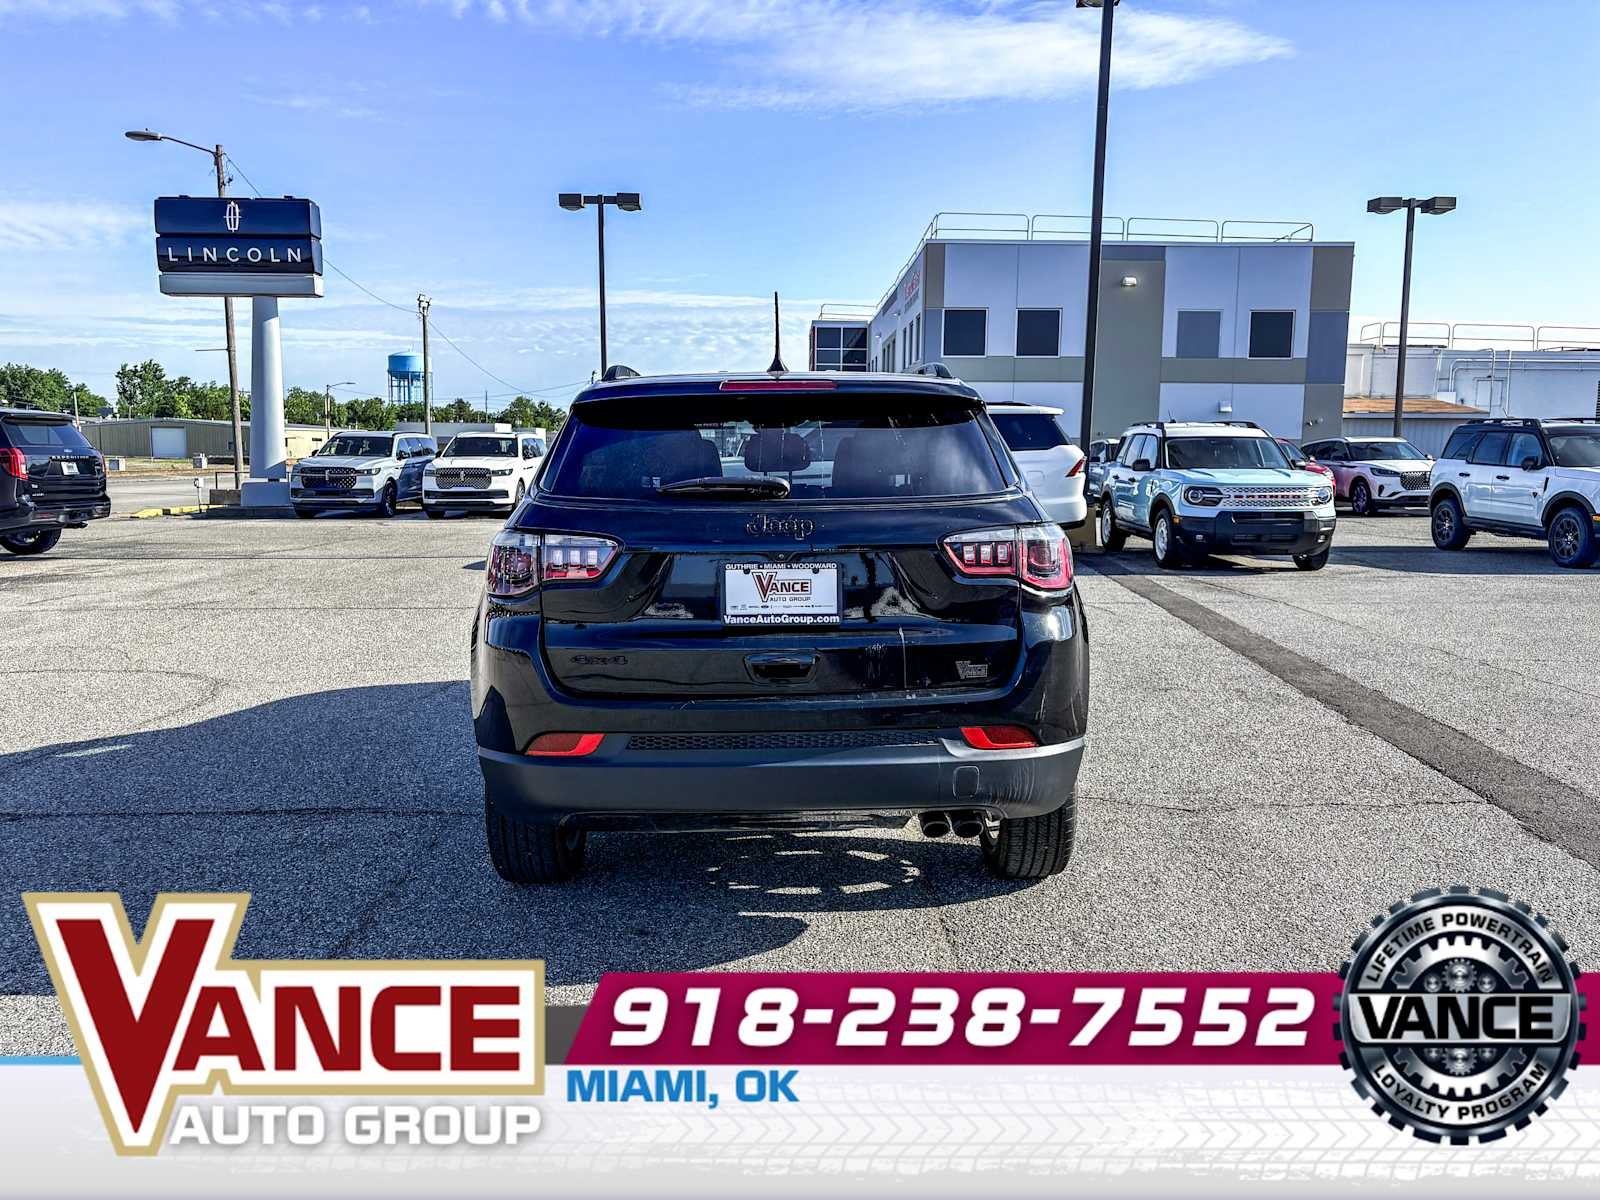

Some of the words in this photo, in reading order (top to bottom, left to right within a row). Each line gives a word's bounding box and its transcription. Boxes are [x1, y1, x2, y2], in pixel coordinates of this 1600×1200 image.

[167, 247, 302, 262] LINCOLN
[746, 513, 814, 540] Jeep
[755, 574, 809, 599] VANCE
[723, 615, 840, 624] VanceAutoGroup.com
